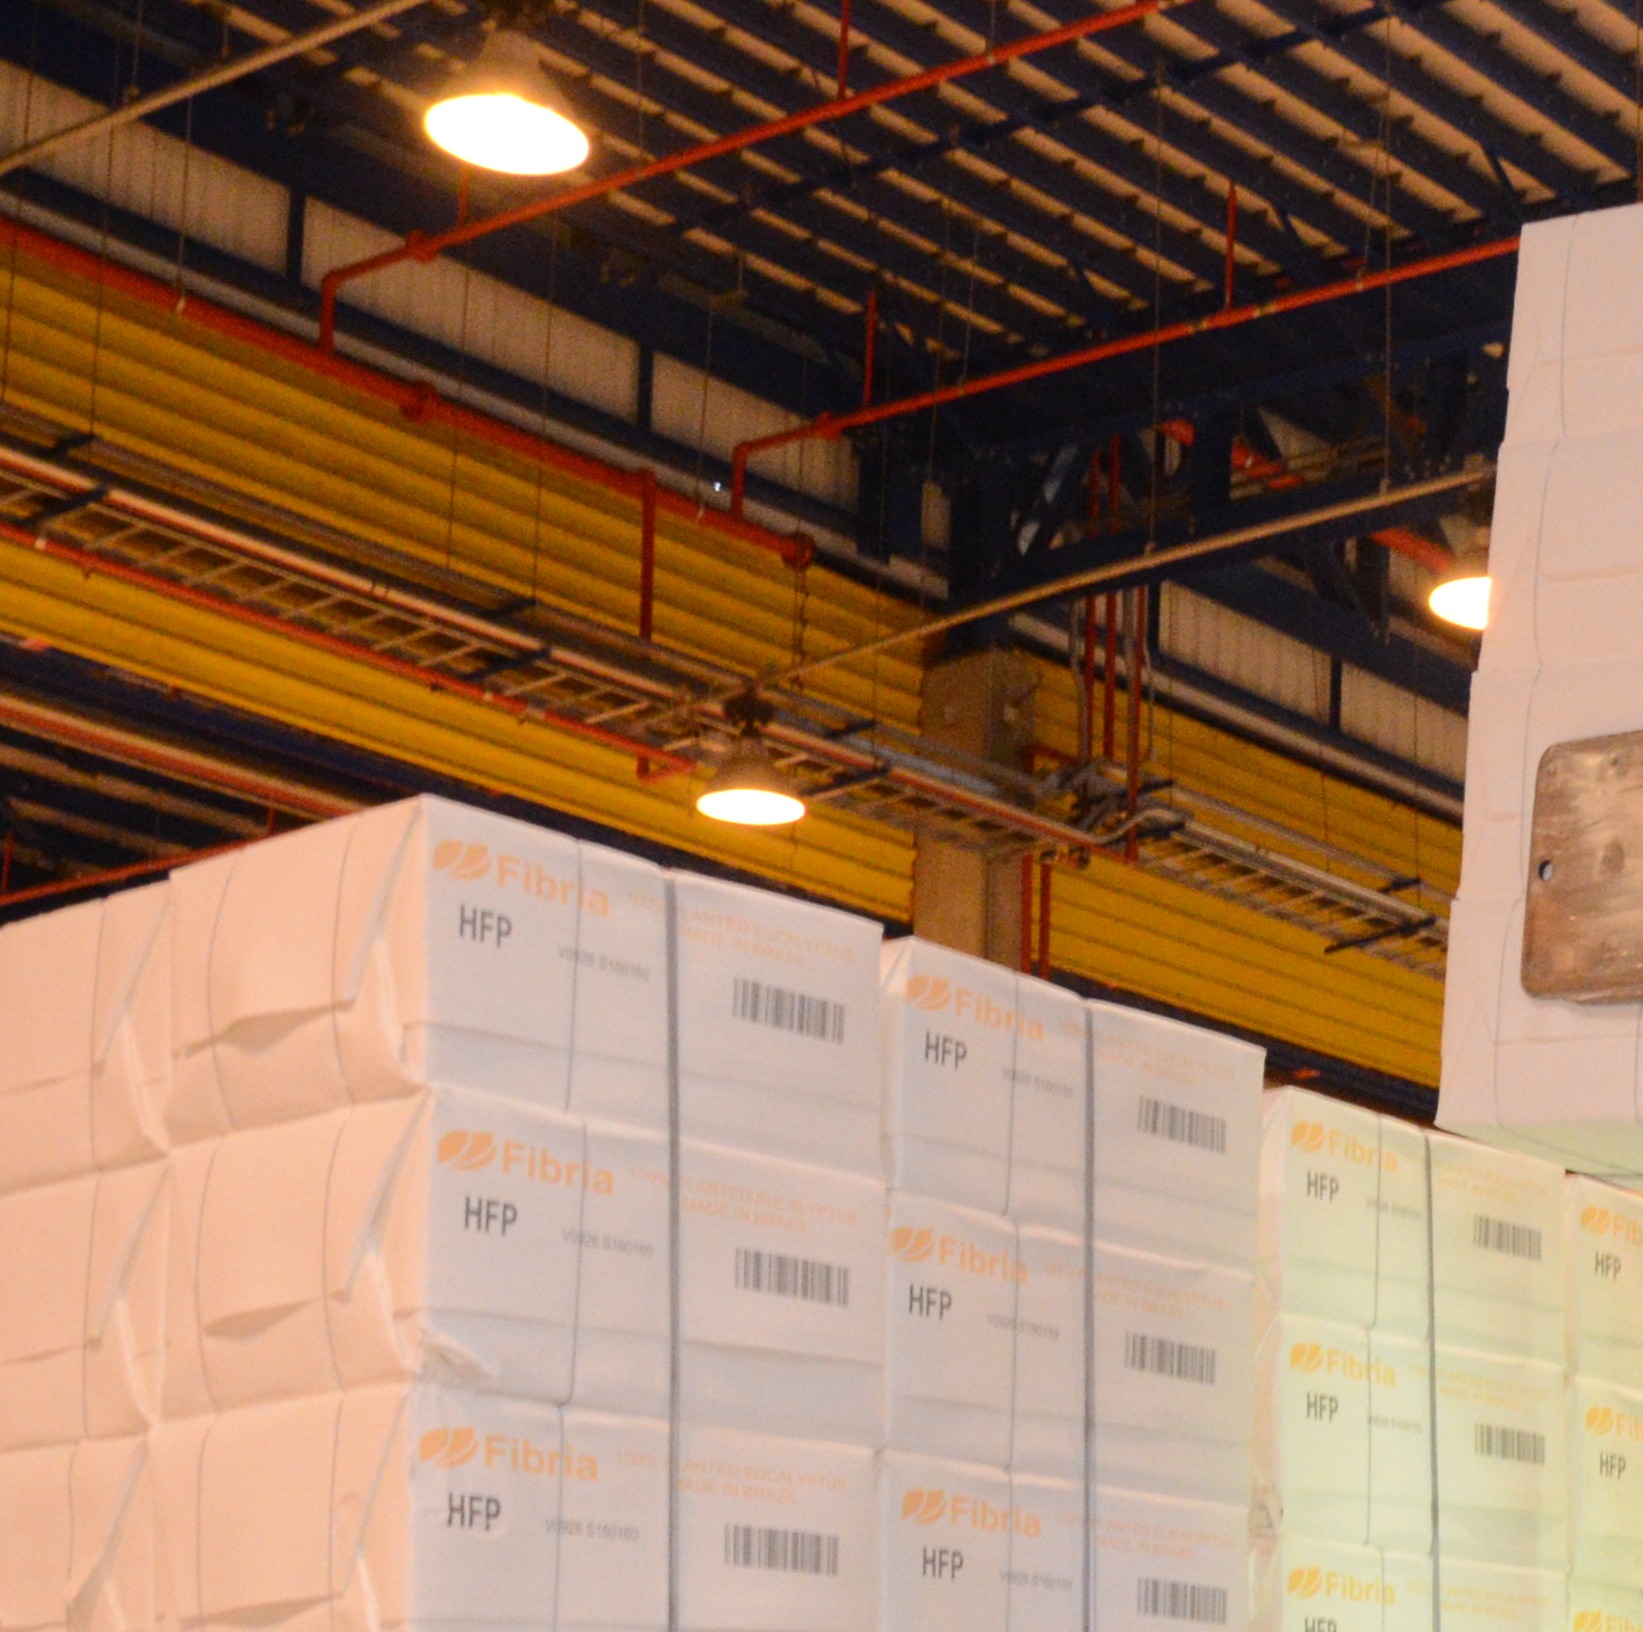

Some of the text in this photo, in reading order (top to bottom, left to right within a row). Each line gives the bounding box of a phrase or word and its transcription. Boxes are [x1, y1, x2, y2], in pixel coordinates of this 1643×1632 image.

[495, 854, 611, 920] Fibria
[459, 906, 512, 948] HFP
[955, 988, 1044, 1041] Fibria
[924, 1033, 968, 1070] HFP
[502, 1141, 614, 1197] Fibria
[1326, 1127, 1400, 1174] Fibria
[672, 1174, 751, 1201] LANTED
[1306, 1173, 1339, 1200] HFP
[464, 1198, 516, 1236] HFP
[939, 1234, 1028, 1283] Fibria
[1594, 1252, 1622, 1280] HFP
[909, 1286, 952, 1321] HFP
[1324, 1348, 1397, 1387] Fibria
[1306, 1394, 1338, 1422] HFP
[484, 1435, 599, 1481] Fibria
[1599, 1452, 1627, 1479] HFP
[447, 1494, 502, 1530] HFP
[950, 1496, 1041, 1538] Fibria
[922, 1548, 964, 1580] HFP
[1324, 1571, 1396, 1607] Fibria
